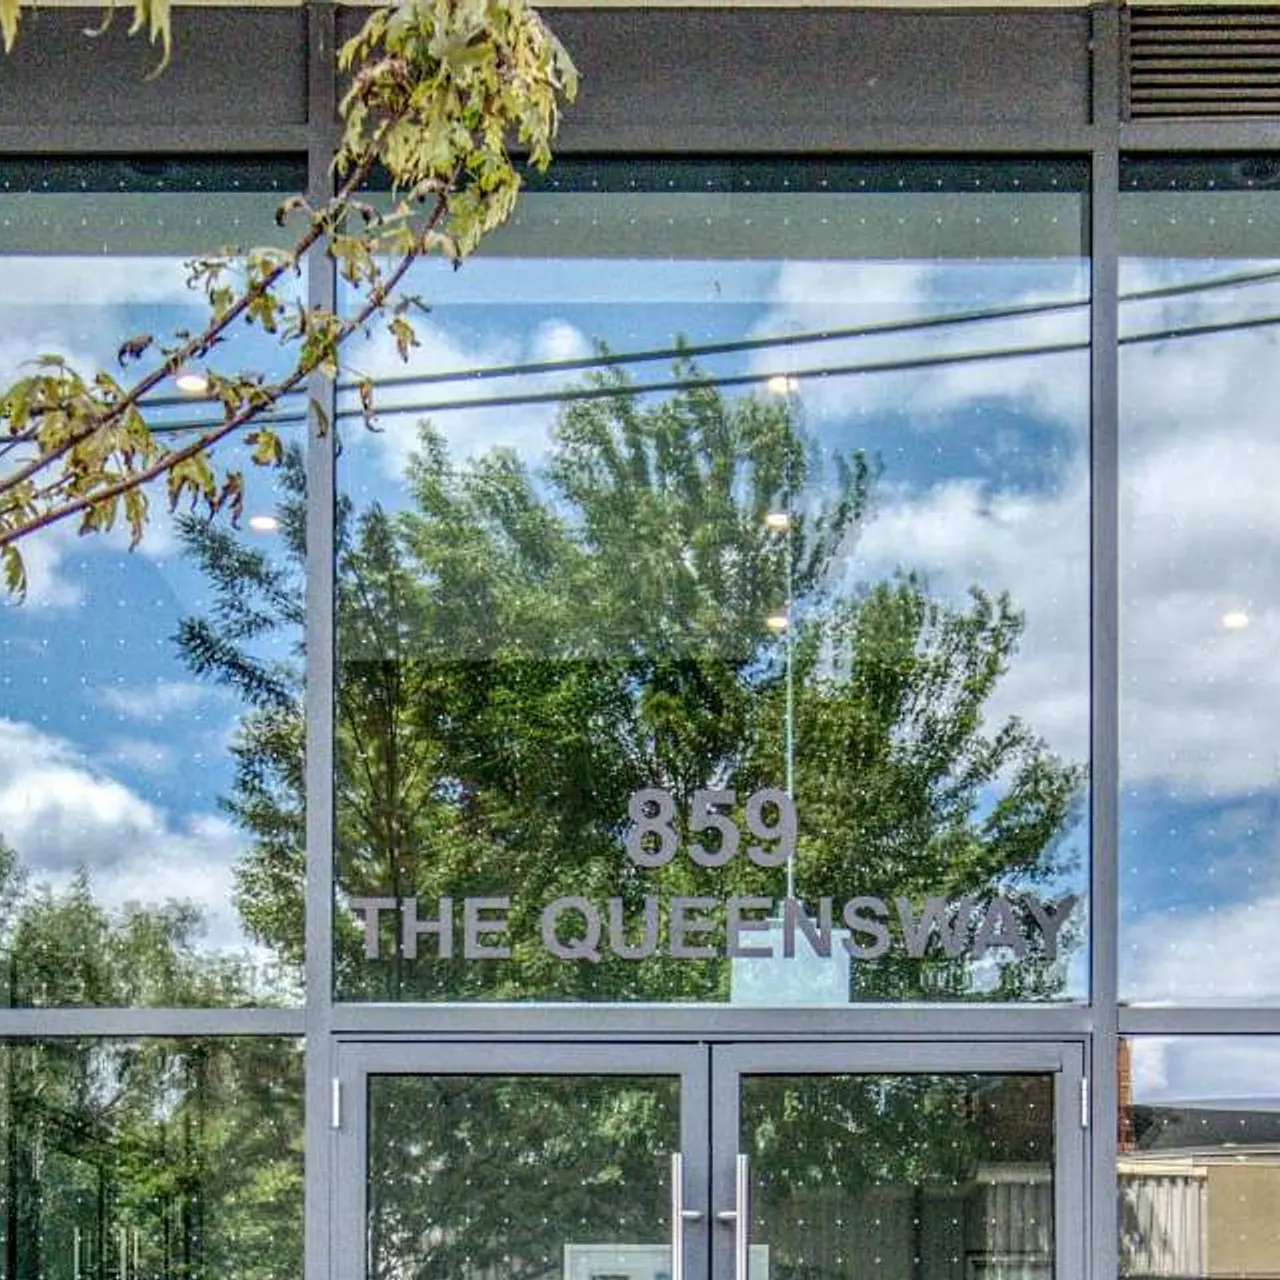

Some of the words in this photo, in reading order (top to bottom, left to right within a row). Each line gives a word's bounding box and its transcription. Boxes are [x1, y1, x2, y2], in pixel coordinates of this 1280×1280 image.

[622, 788, 801, 870] 859
[351, 896, 513, 961] THE
[540, 897, 1077, 964] QUEENSWAY
